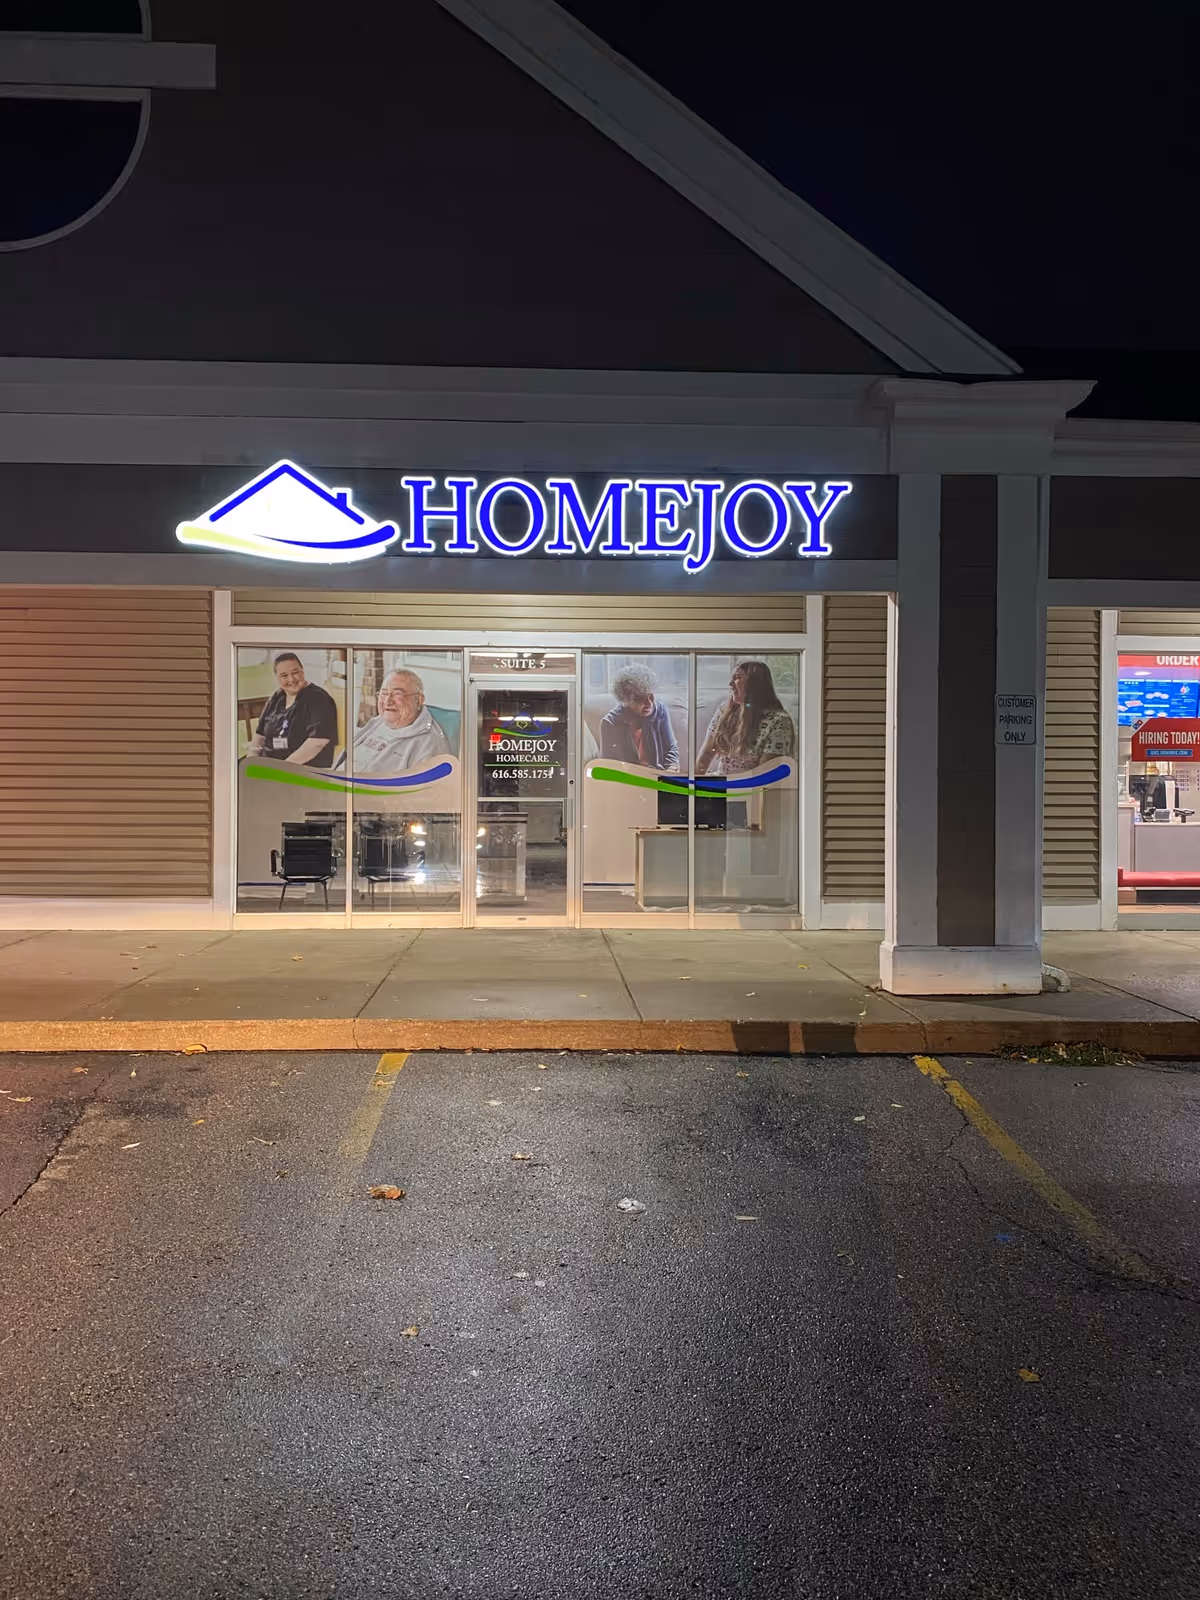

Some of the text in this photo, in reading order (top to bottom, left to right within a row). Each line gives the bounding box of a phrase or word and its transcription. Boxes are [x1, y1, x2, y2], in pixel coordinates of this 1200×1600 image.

[401, 476, 852, 573] HOMEJOY
[500, 659, 546, 669] SUITE 5
[997, 698, 1034, 708] CUSTOMER
[999, 714, 1032, 724] PARKING
[1004, 731, 1026, 742] ONLY
[1138, 731, 1200, 745] HIRING TODAY!
[488, 739, 556, 753] HOMEJOY
[496, 754, 550, 763] HOMECARE
